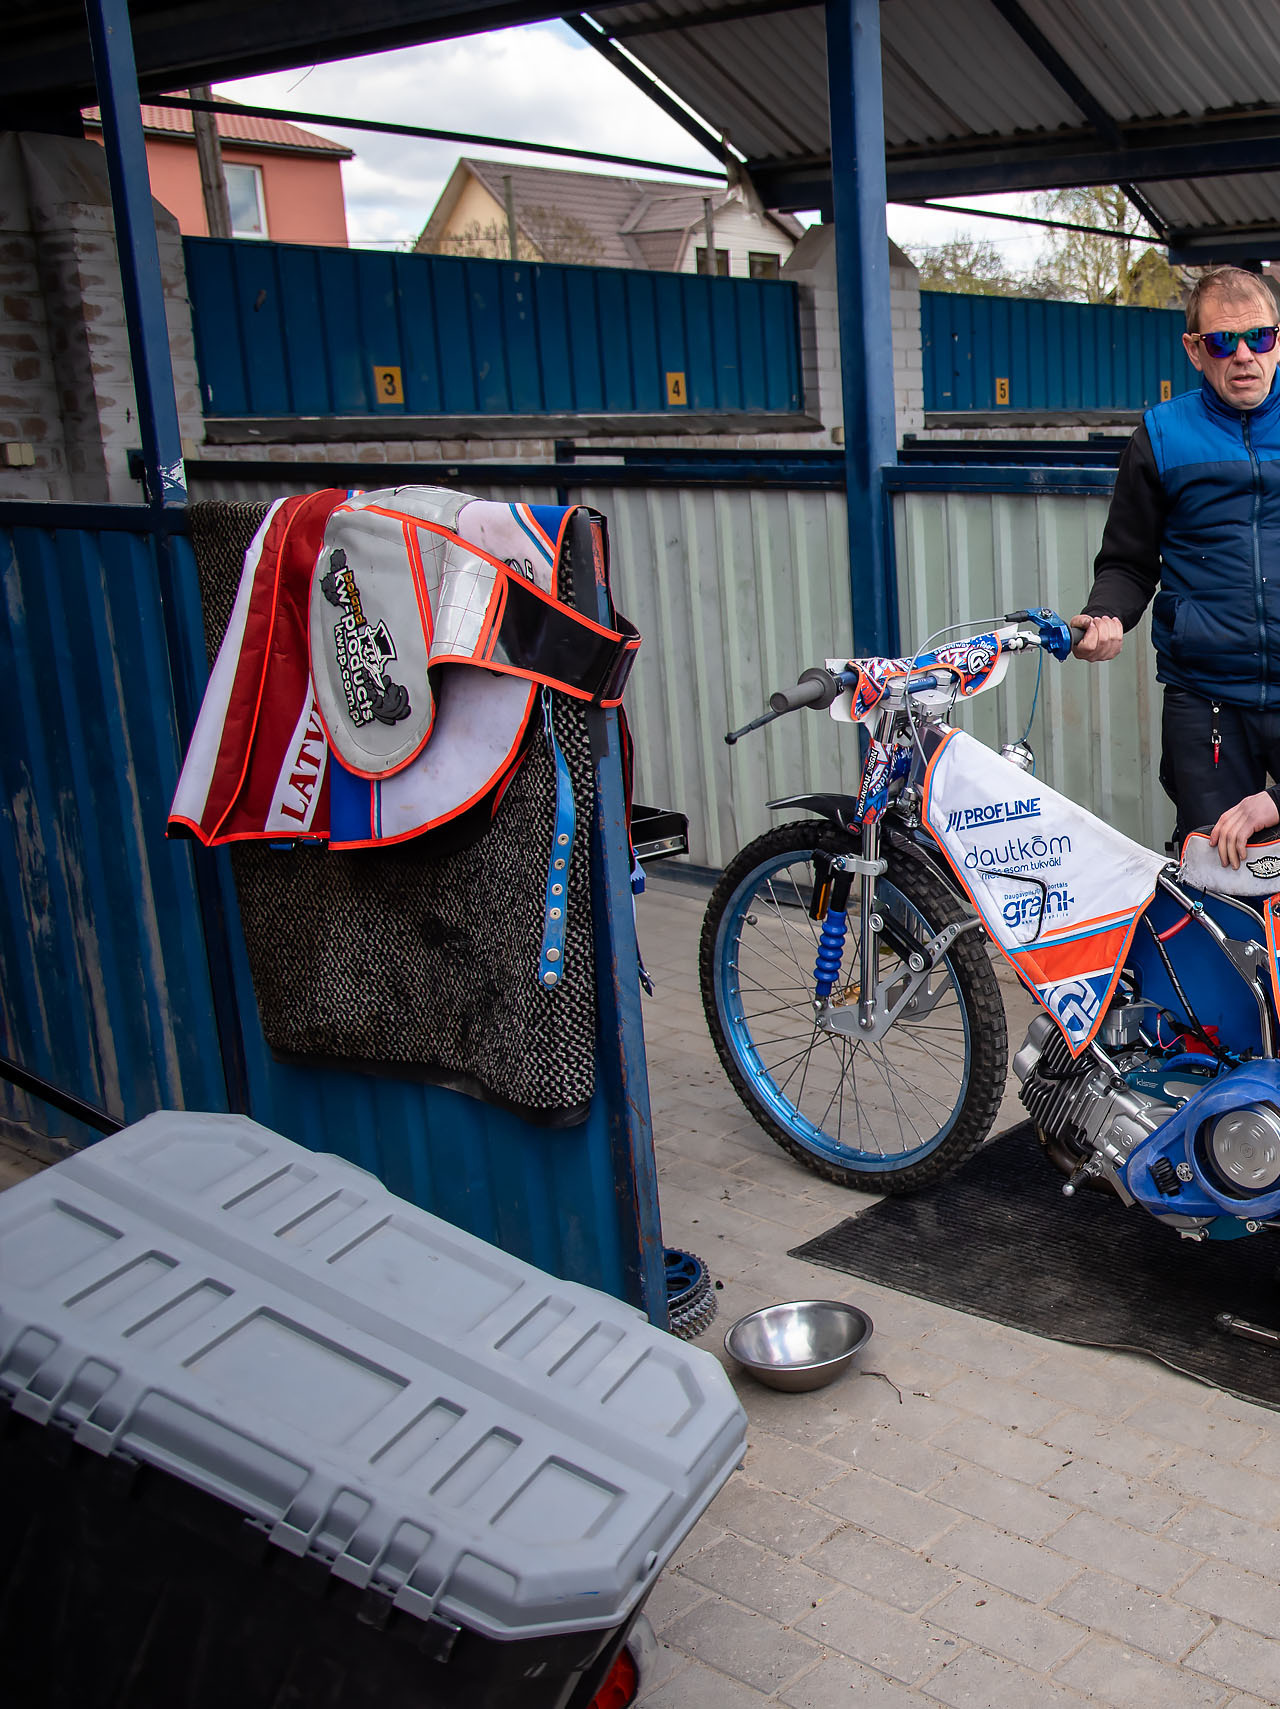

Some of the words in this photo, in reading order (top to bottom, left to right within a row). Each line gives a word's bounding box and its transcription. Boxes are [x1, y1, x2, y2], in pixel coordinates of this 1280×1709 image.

[383, 373, 397, 396] 3
[672, 380, 681, 397] 4
[1000, 382, 1006, 399] 5
[343, 571, 367, 625] poland
[334, 567, 374, 721] kw-products
[334, 623, 364, 728] kwsp.com.pl
[280, 700, 325, 824] LATV
[1003, 864, 1029, 874] esam
[1003, 891, 1068, 928] grani
